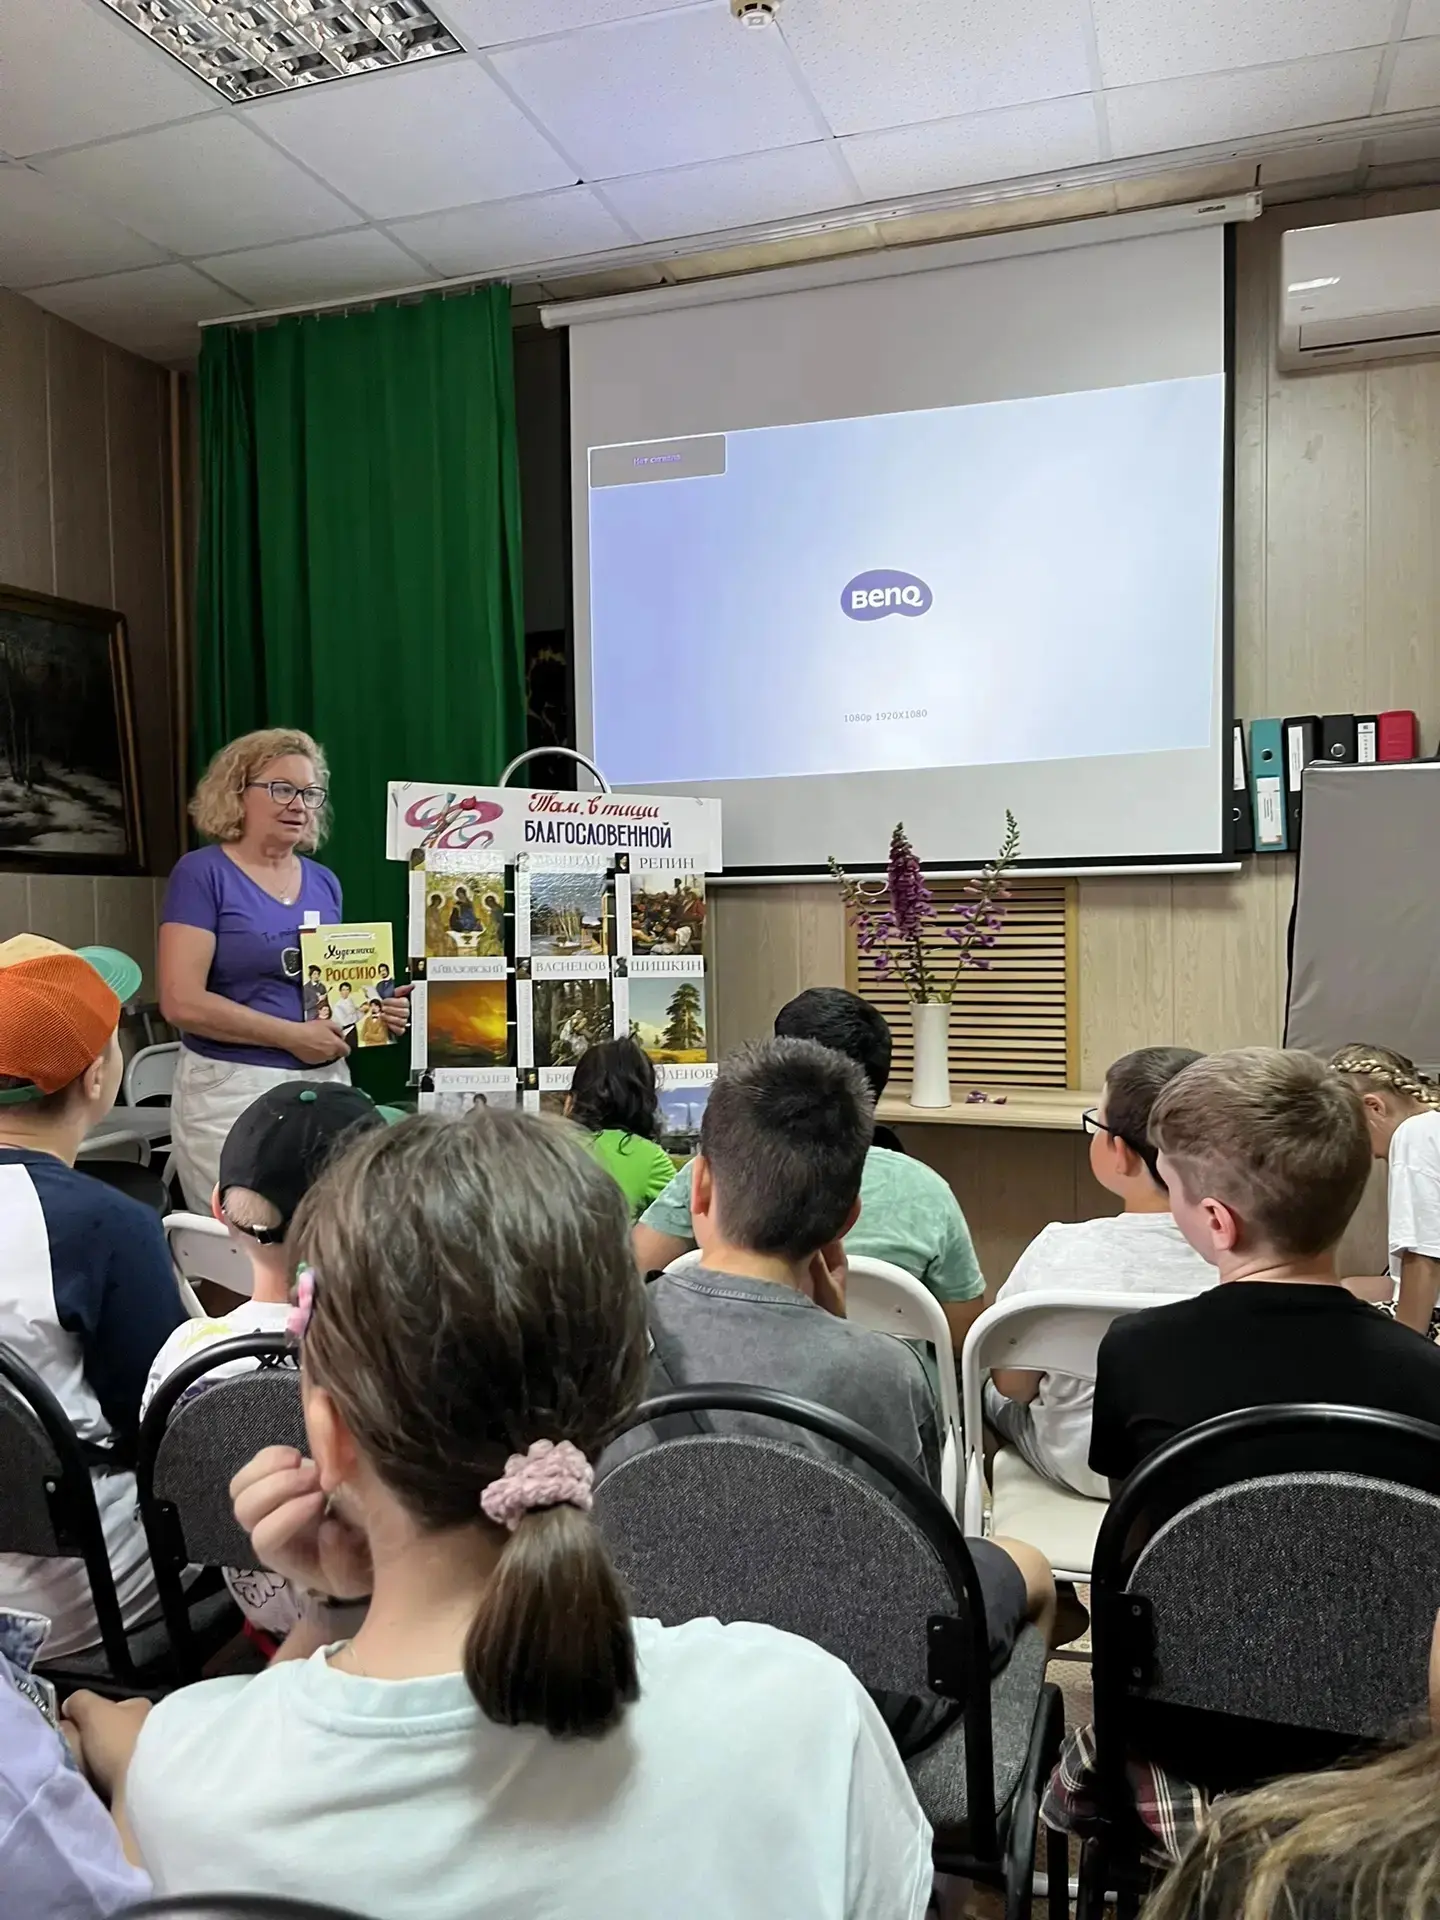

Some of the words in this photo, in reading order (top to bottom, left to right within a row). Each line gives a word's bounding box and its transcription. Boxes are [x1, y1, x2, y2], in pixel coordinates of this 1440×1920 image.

[851, 585, 924, 609] BenQ
[844, 713, 872, 723] 1080p
[524, 820, 672, 848] БЛАГОСЛОВЕННОЙ
[639, 857, 694, 869] РЕПИН
[535, 961, 606, 973] ВАСНЕЦОВ
[630, 959, 701, 971] ШИШКИН
[325, 966, 376, 981] РОССИЮ
